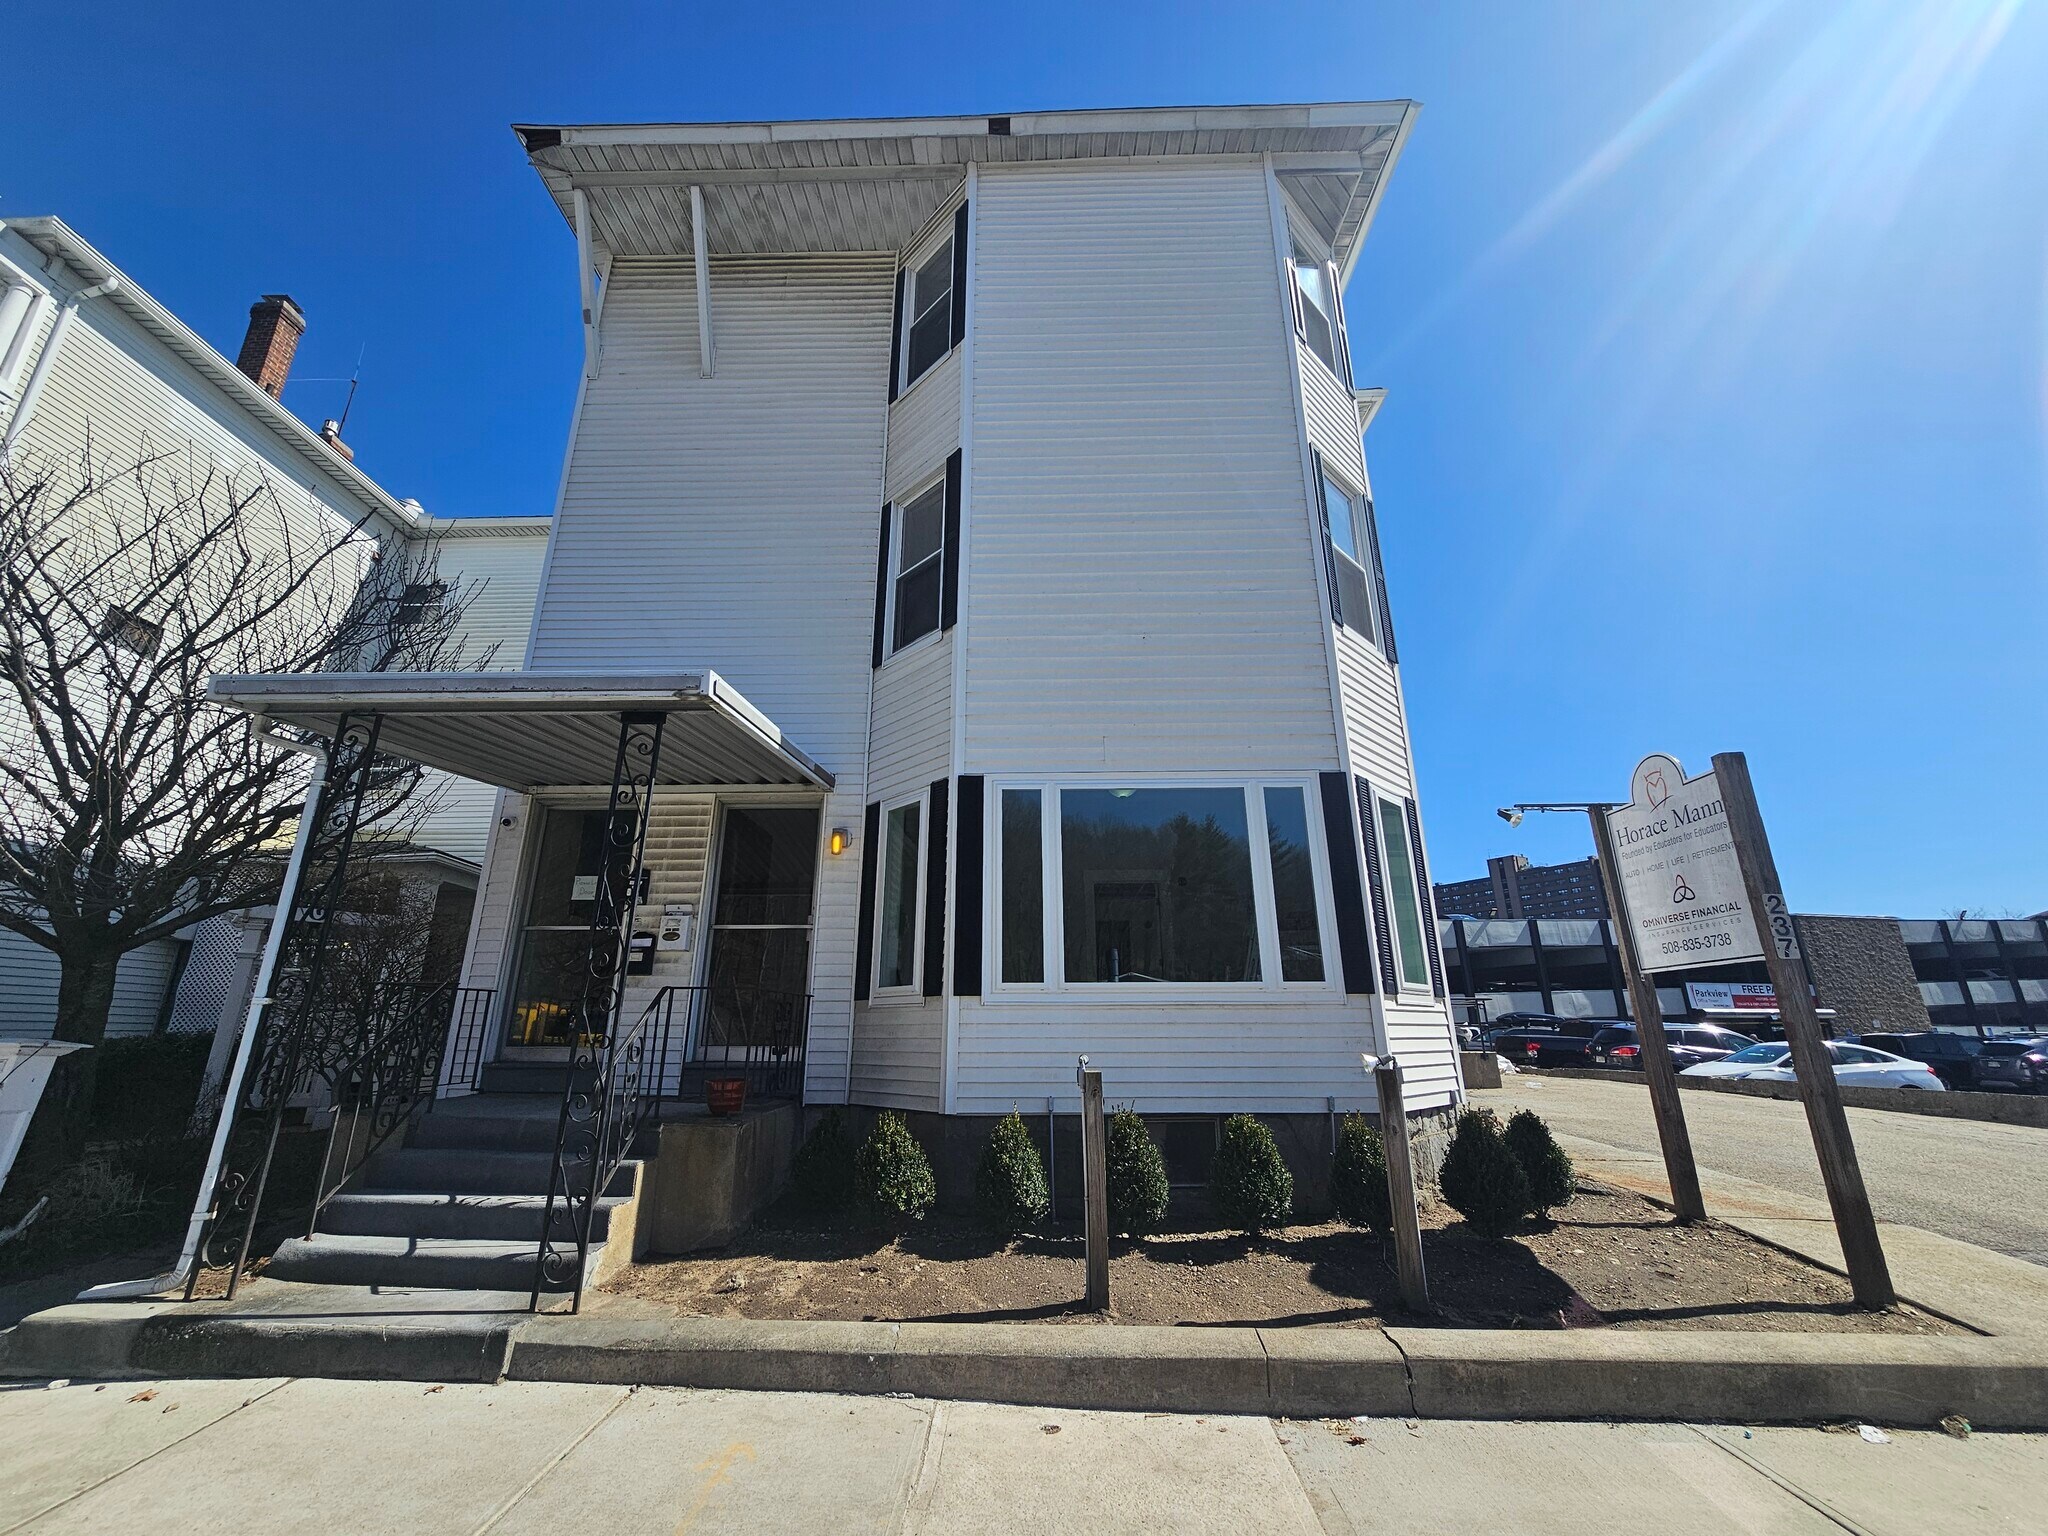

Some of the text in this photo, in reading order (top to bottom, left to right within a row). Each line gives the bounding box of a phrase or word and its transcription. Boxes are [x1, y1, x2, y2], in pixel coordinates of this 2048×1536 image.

[1616, 799, 1725, 847] Horace Mann
[1622, 820, 1728, 860] Founded by Educators for Educators
[1625, 841, 1735, 879] AUTO HOME LIFE RETIREMENT
[1642, 901, 1742, 928] OMNIVERSE FINANCIAL
[1648, 917, 1742, 938] INSURANCE SERVICES
[1767, 895, 1793, 958] 237
[1662, 932, 1732, 955] 508-835-3738
[1695, 989, 1729, 998] Parkview
[1741, 985, 1765, 994] FREE
